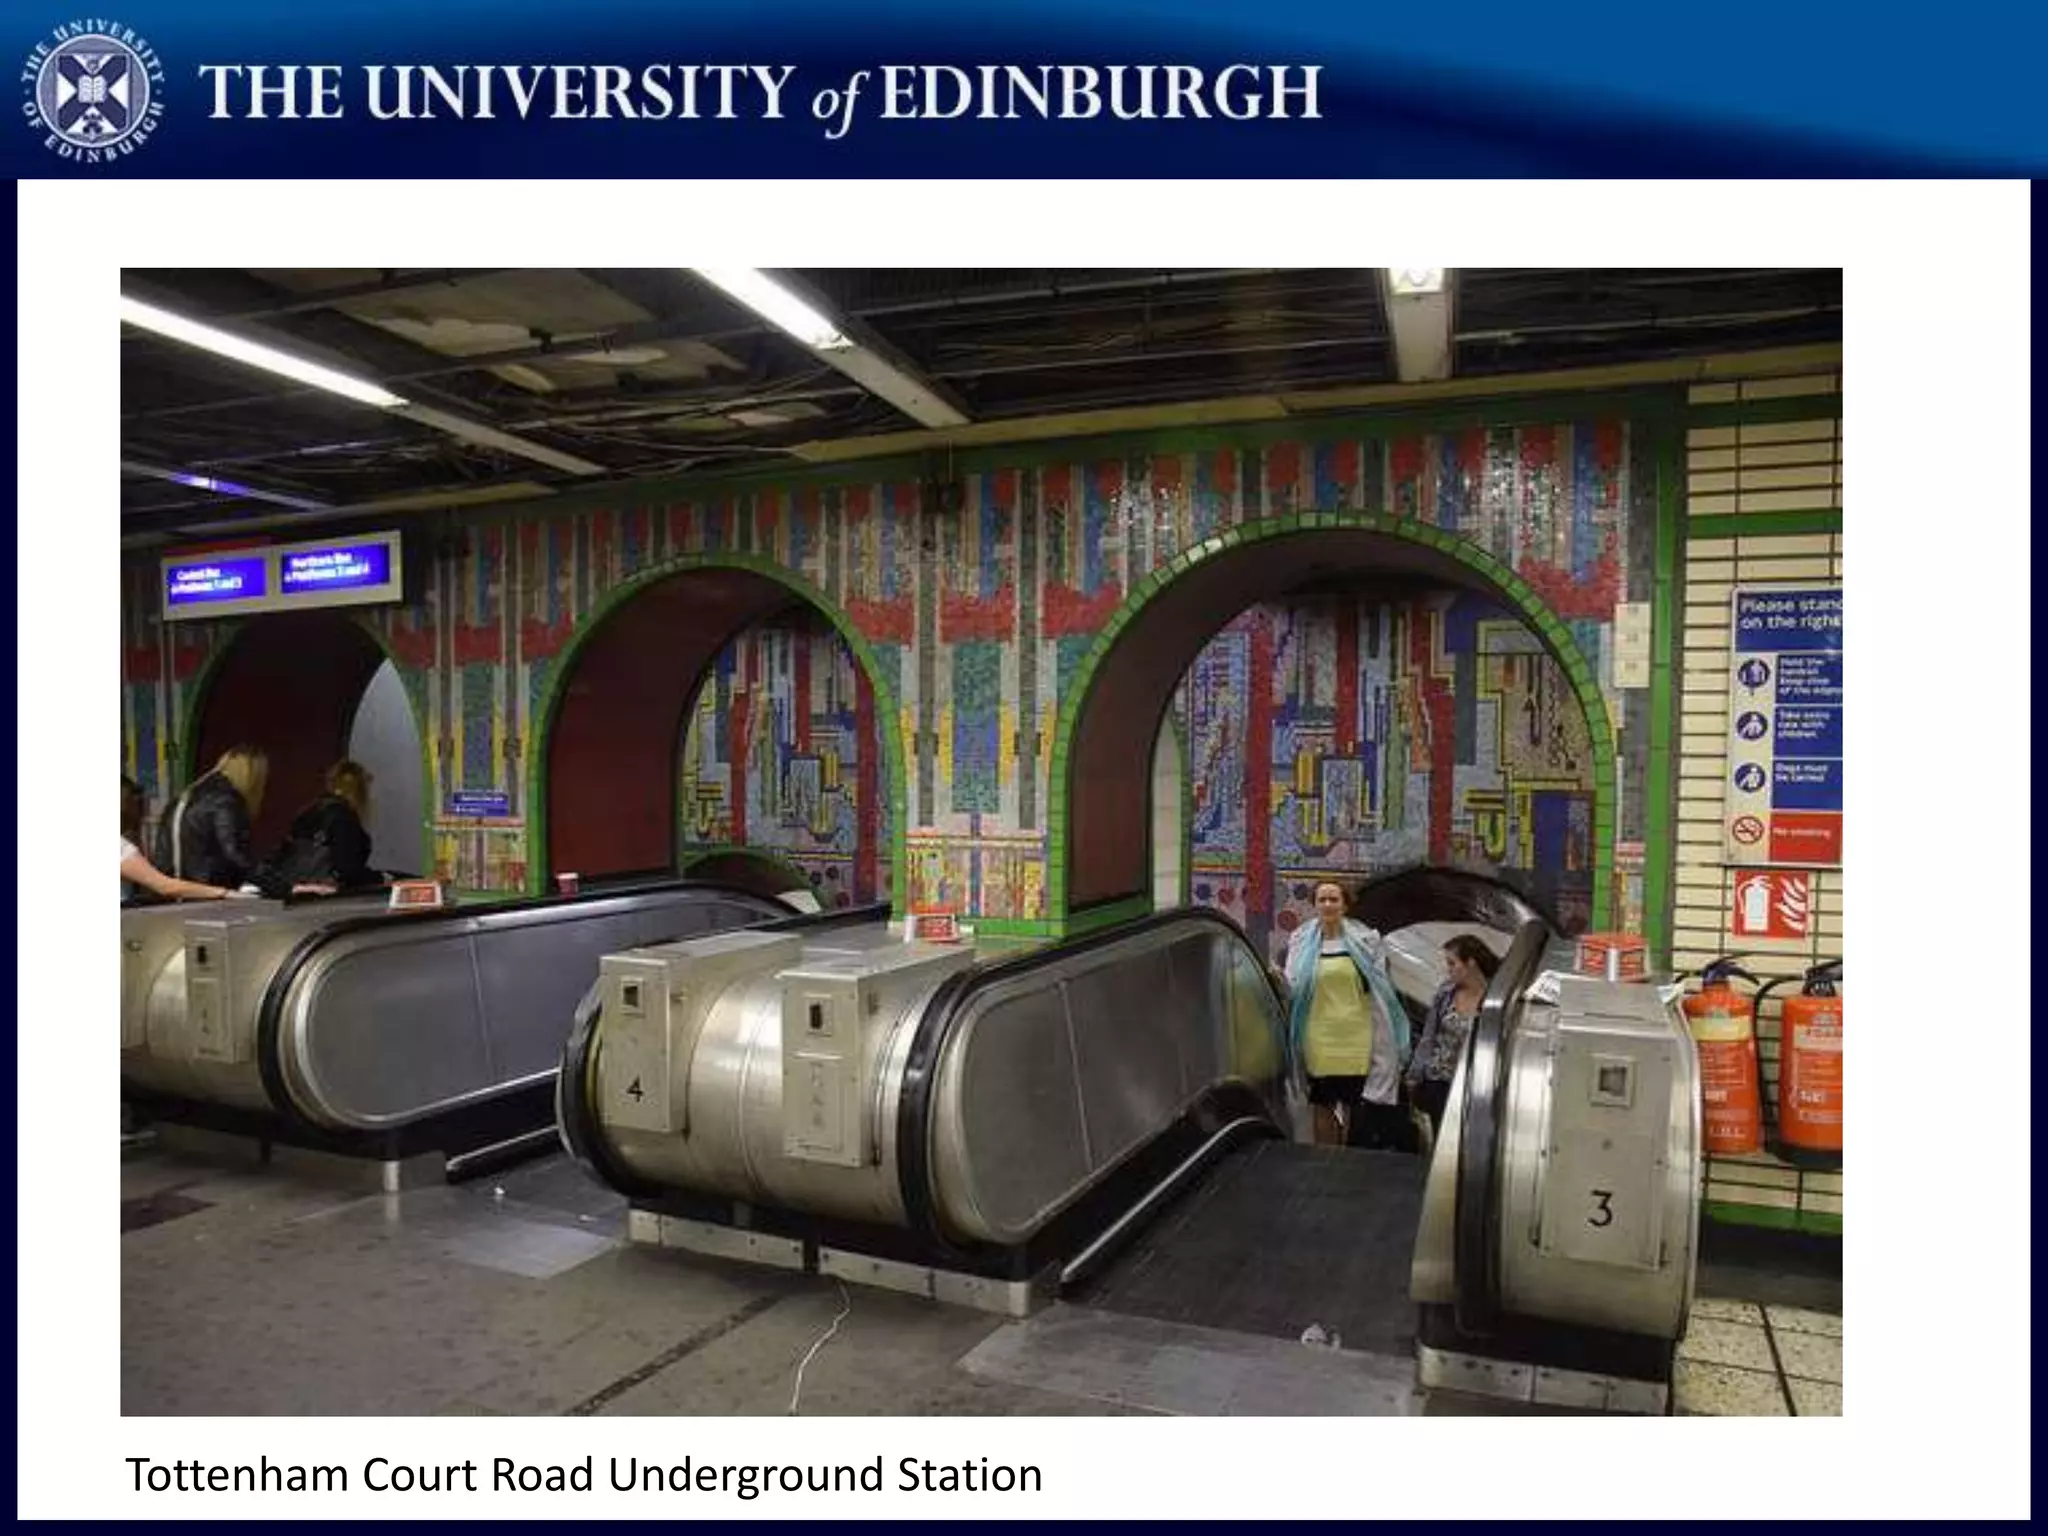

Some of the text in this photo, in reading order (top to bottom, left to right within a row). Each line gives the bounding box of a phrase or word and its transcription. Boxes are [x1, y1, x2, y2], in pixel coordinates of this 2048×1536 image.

[1741, 599, 1796, 614] Please
[1741, 617, 1763, 630] on
[1767, 614, 1796, 629] the
[626, 1076, 644, 1102] 4
[1588, 1190, 1613, 1227] 3
